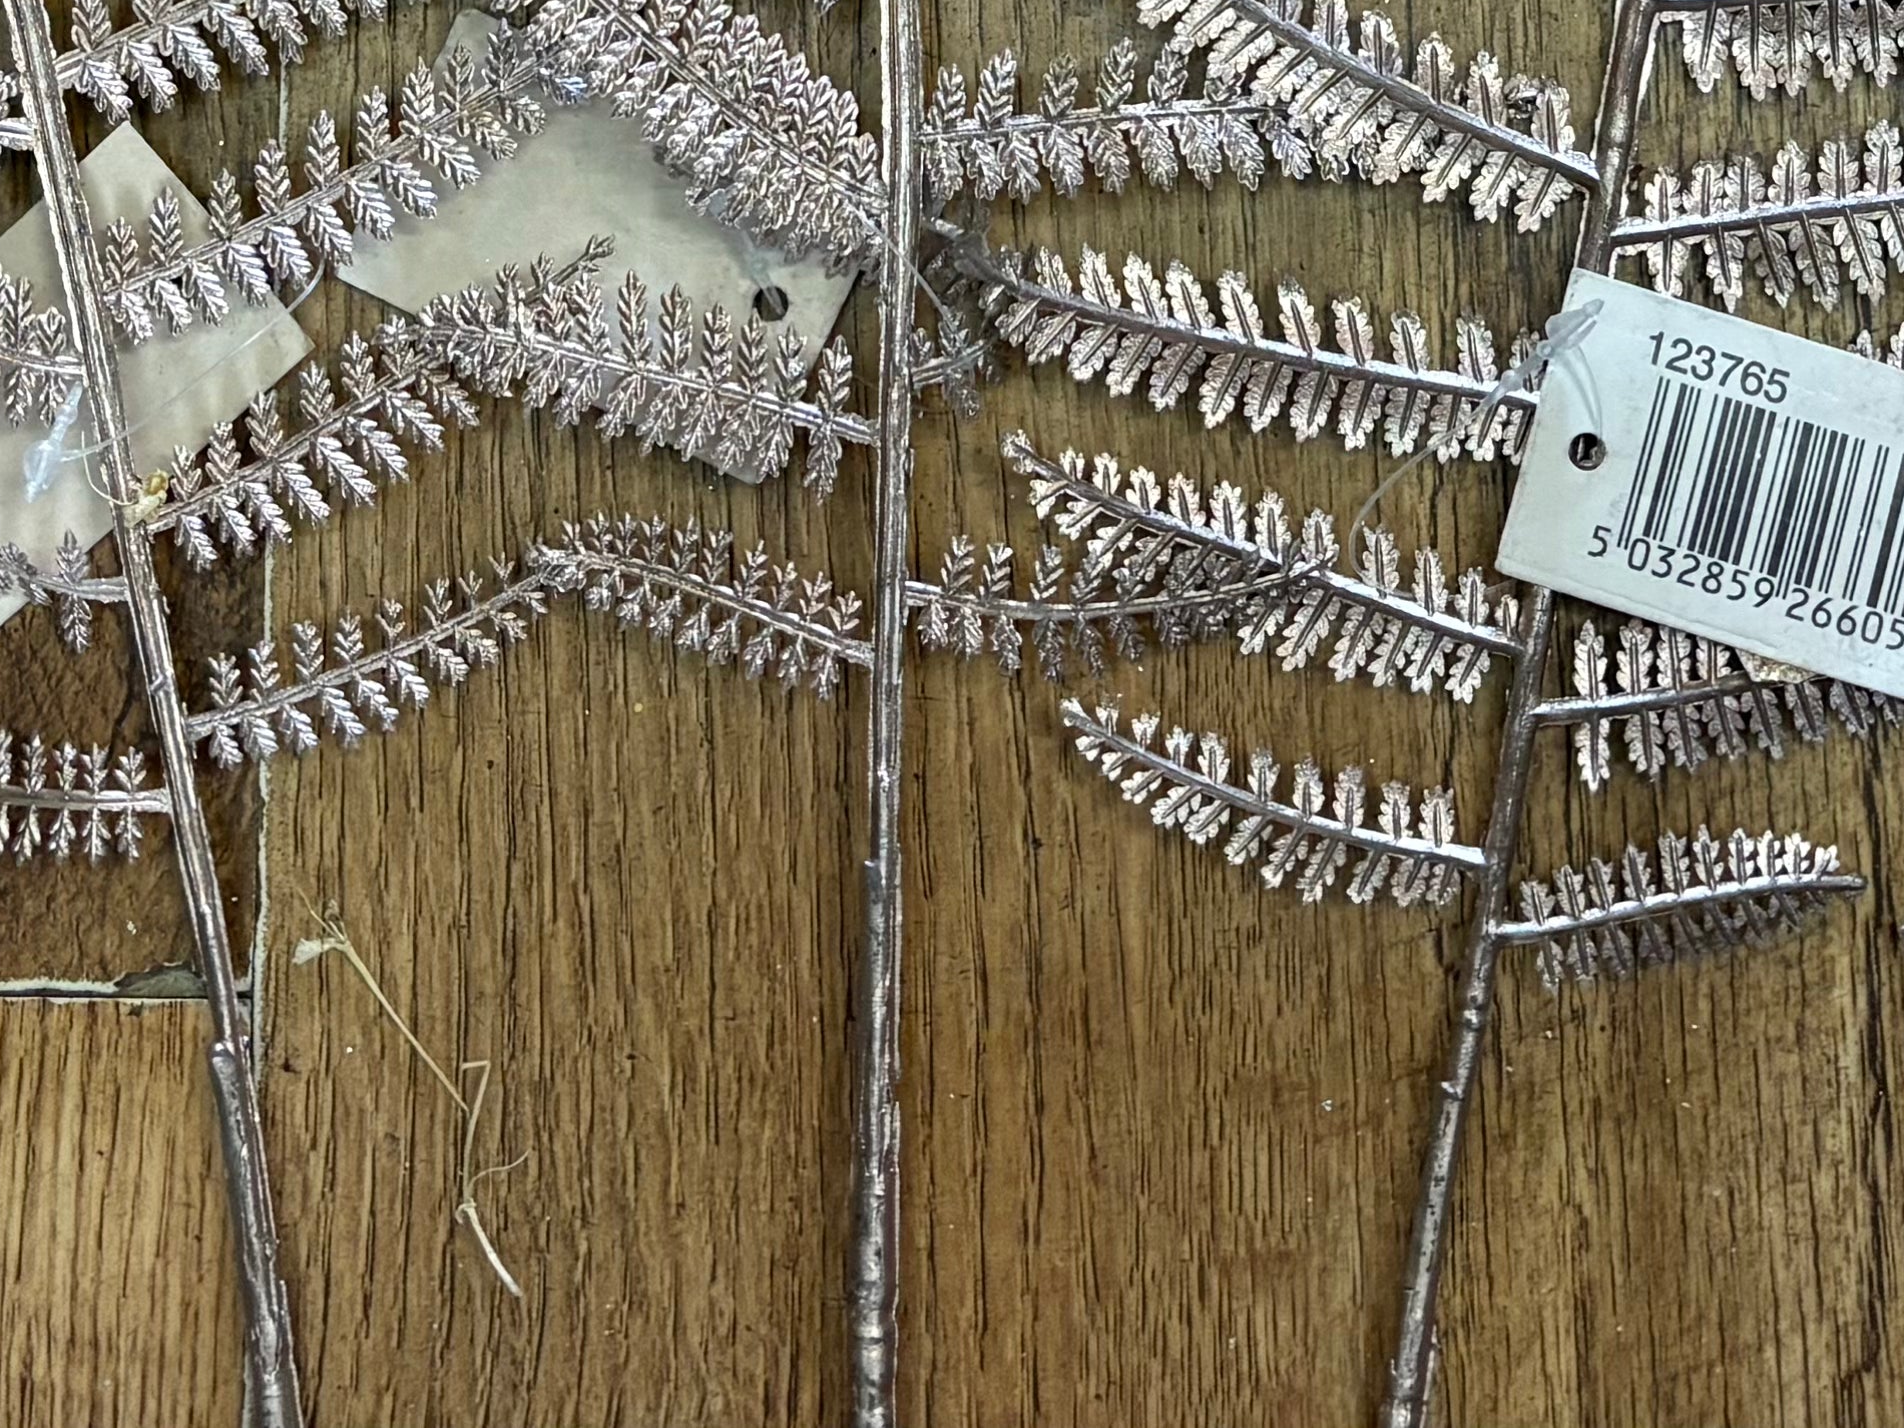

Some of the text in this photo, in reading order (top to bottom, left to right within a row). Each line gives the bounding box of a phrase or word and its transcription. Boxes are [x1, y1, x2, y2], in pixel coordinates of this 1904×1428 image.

[1648, 330, 1791, 404] 123765
[1587, 525, 1612, 559] 5
[1627, 537, 1778, 609] 032859
